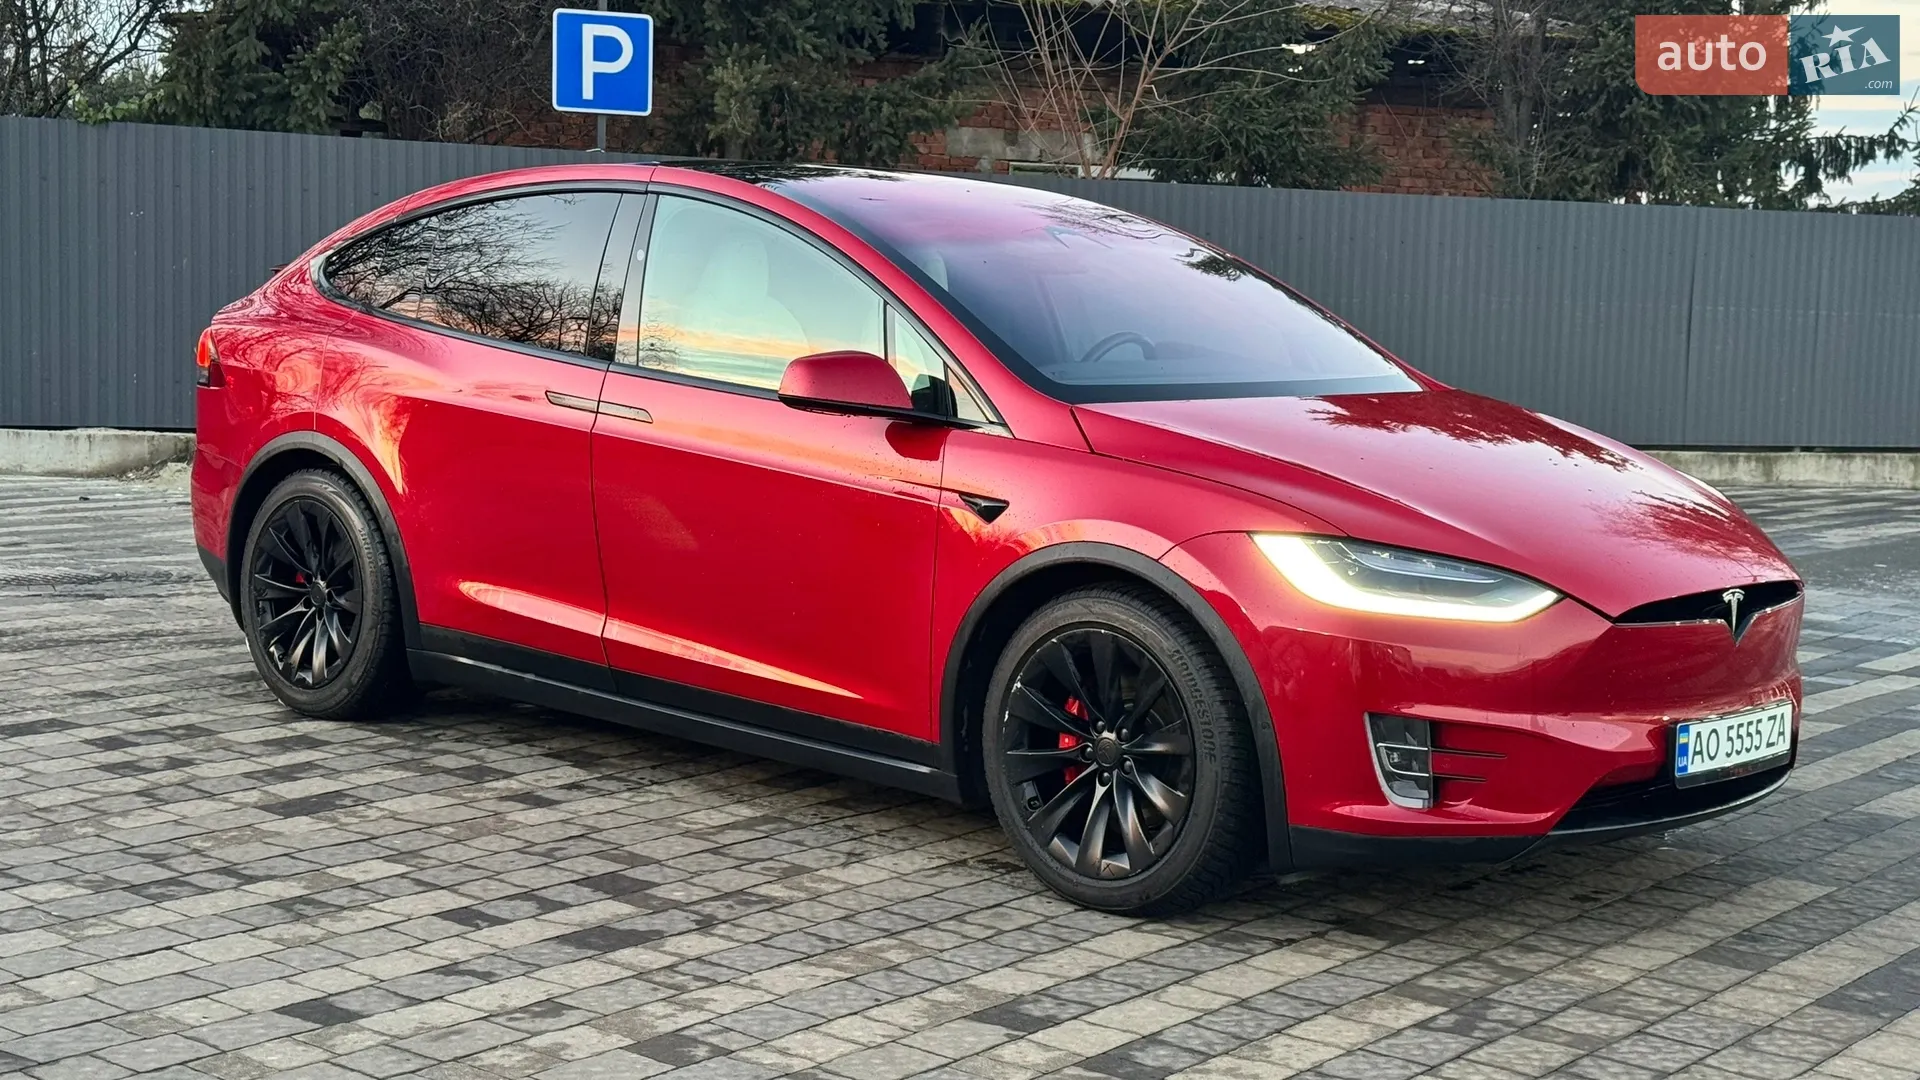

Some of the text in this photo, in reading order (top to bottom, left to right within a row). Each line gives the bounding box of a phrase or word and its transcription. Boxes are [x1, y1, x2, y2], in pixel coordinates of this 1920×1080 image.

[581, 23, 634, 100] P
[1678, 755, 1688, 767] UA
[1691, 712, 1786, 765] AO 5555 ZA
